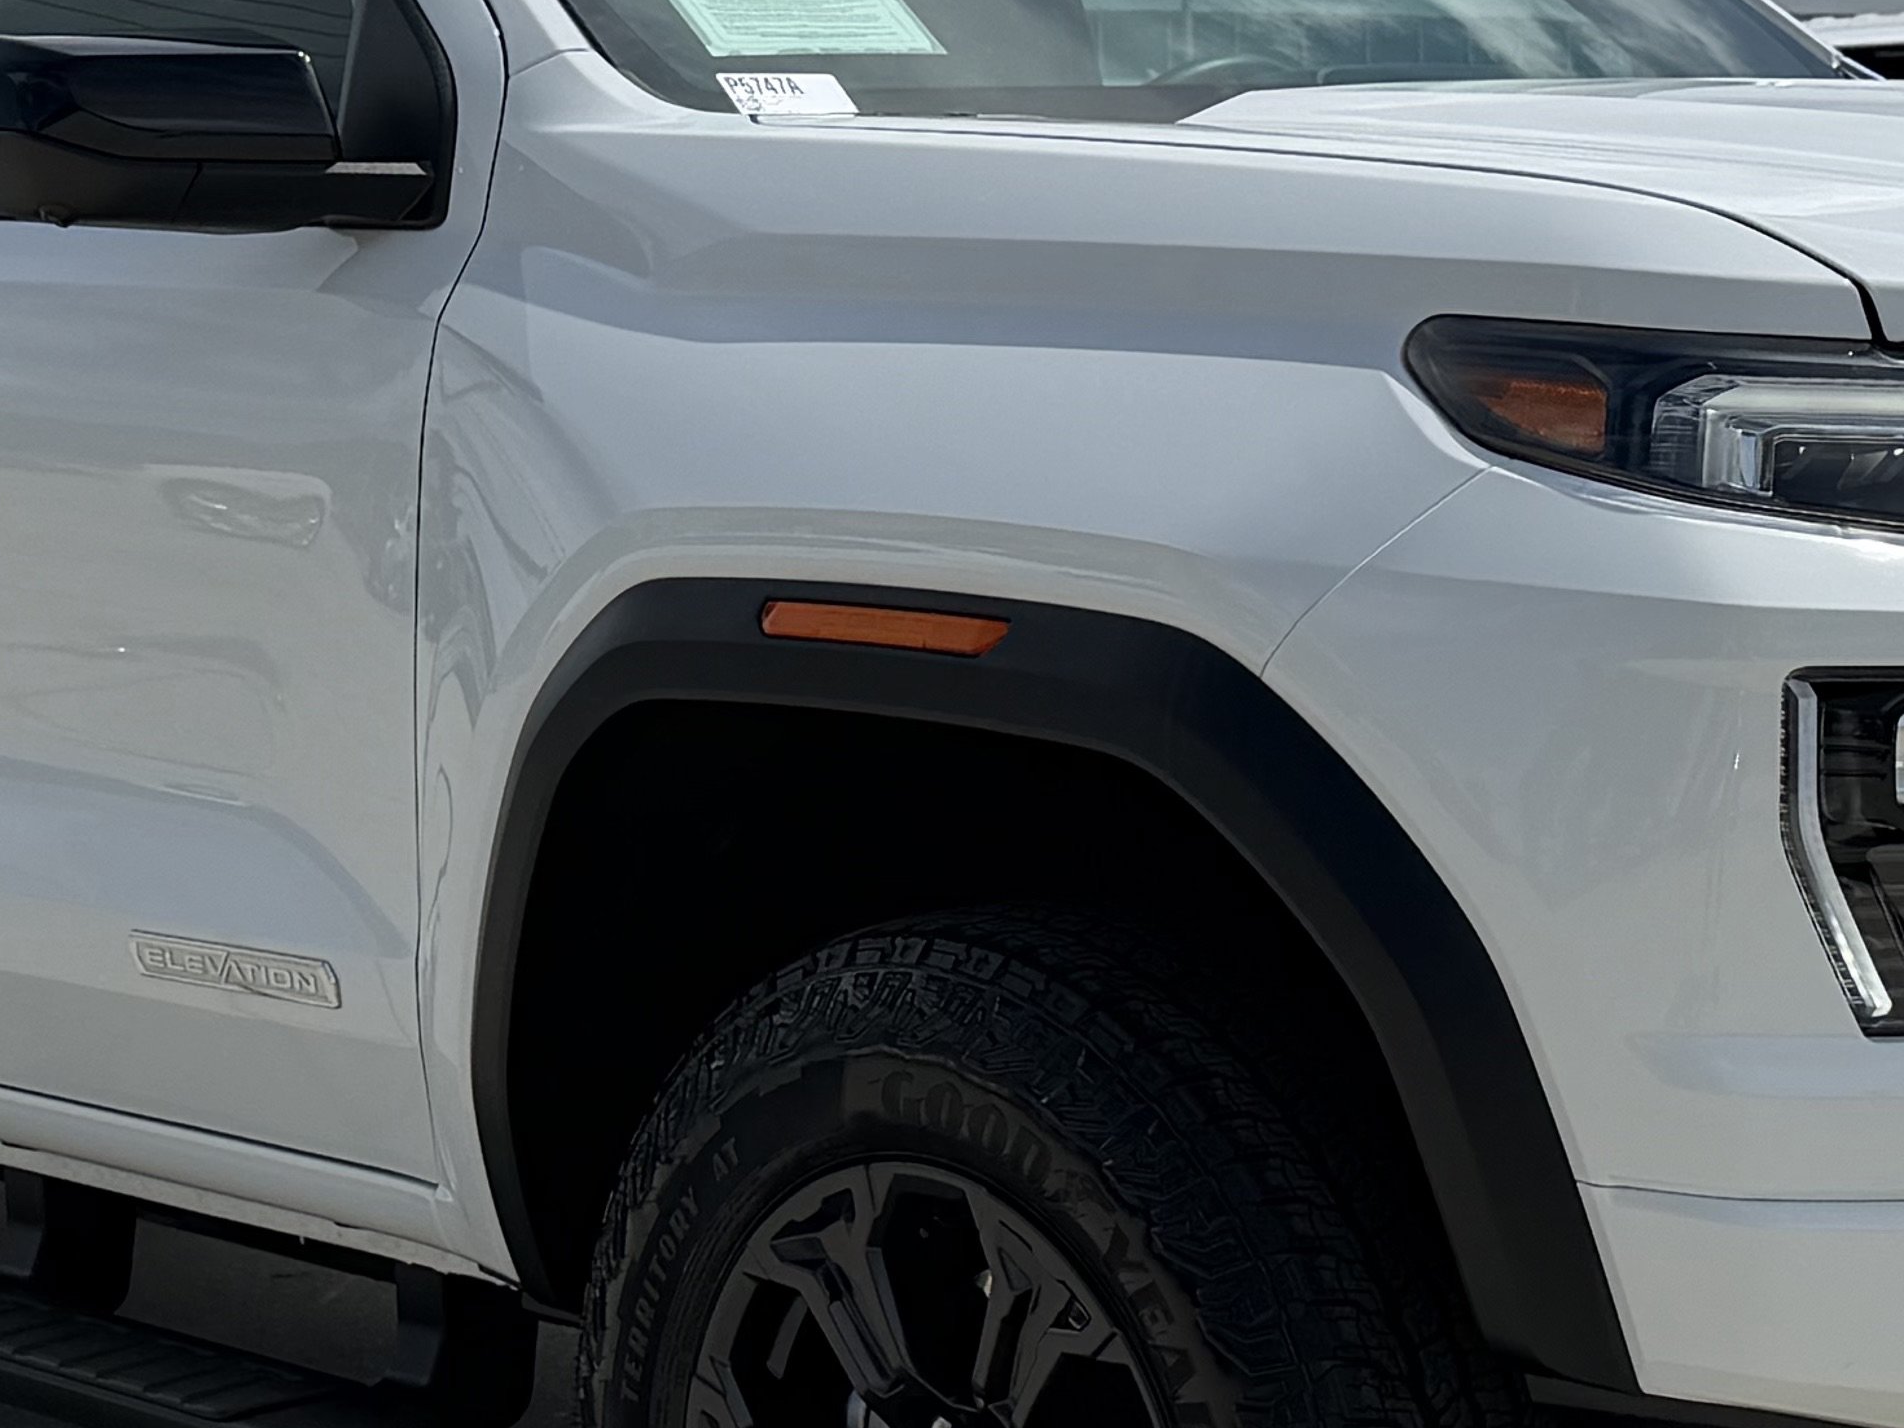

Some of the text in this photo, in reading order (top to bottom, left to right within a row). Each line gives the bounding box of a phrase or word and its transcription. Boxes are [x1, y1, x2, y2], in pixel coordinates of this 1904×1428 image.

[723, 76, 805, 95] P5747A
[143, 945, 319, 996] ELEVATION
[620, 1133, 743, 1407] TERRITORY AT
